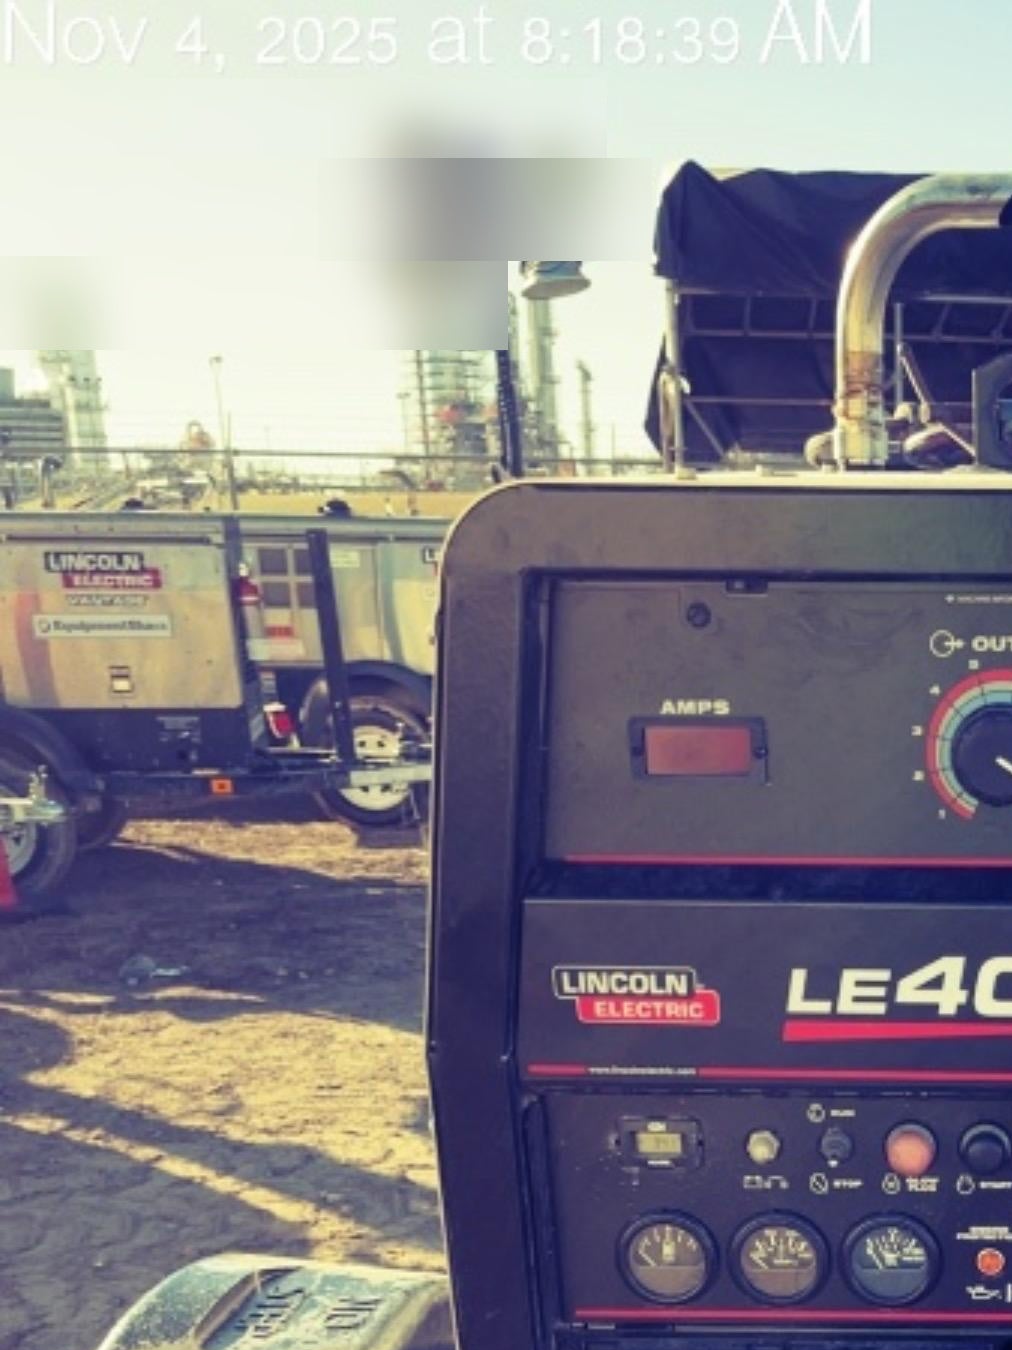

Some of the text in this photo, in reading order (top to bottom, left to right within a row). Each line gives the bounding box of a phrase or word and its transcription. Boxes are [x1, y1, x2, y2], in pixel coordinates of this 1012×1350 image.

[49, 553, 140, 571] LINCOLN
[660, 699, 730, 715] AMPS
[561, 972, 688, 996] LINCOLN
[593, 1002, 704, 1020] ELECTRIC
